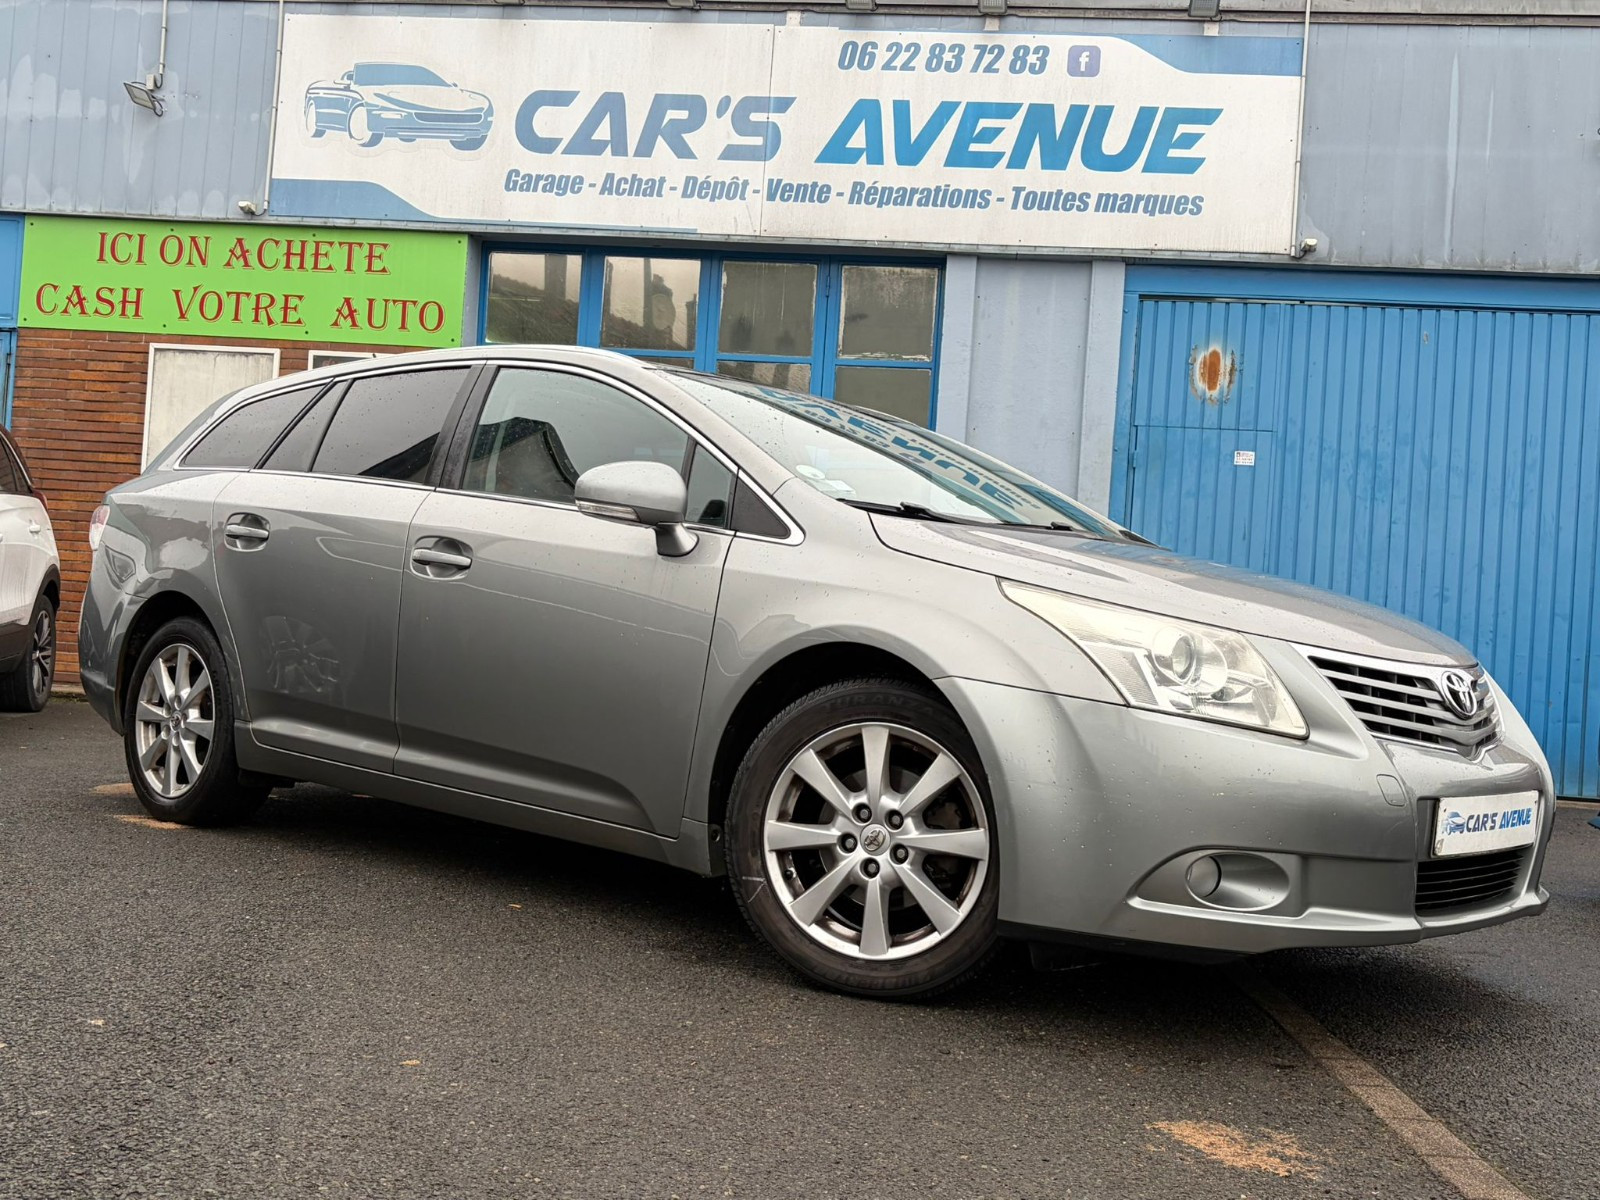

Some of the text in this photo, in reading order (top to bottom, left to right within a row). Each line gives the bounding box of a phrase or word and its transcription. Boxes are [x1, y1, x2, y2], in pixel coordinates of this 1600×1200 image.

[838, 40, 1050, 76] 06 22 83 72 83
[515, 90, 1224, 177] CAR'S AVENUE
[505, 168, 584, 197] Garage
[600, 173, 665, 198] Achat
[682, 173, 748, 203] Dépôt
[766, 178, 832, 204] Vente
[848, 180, 993, 210] Réparations
[1010, 186, 1091, 213] Toutes
[1094, 192, 1204, 218] marques
[97, 231, 391, 275] ICI ON ACHETE
[35, 282, 446, 334] CASH VOTRE AUTO
[1466, 808, 1532, 832] CAR'S AVENUE
